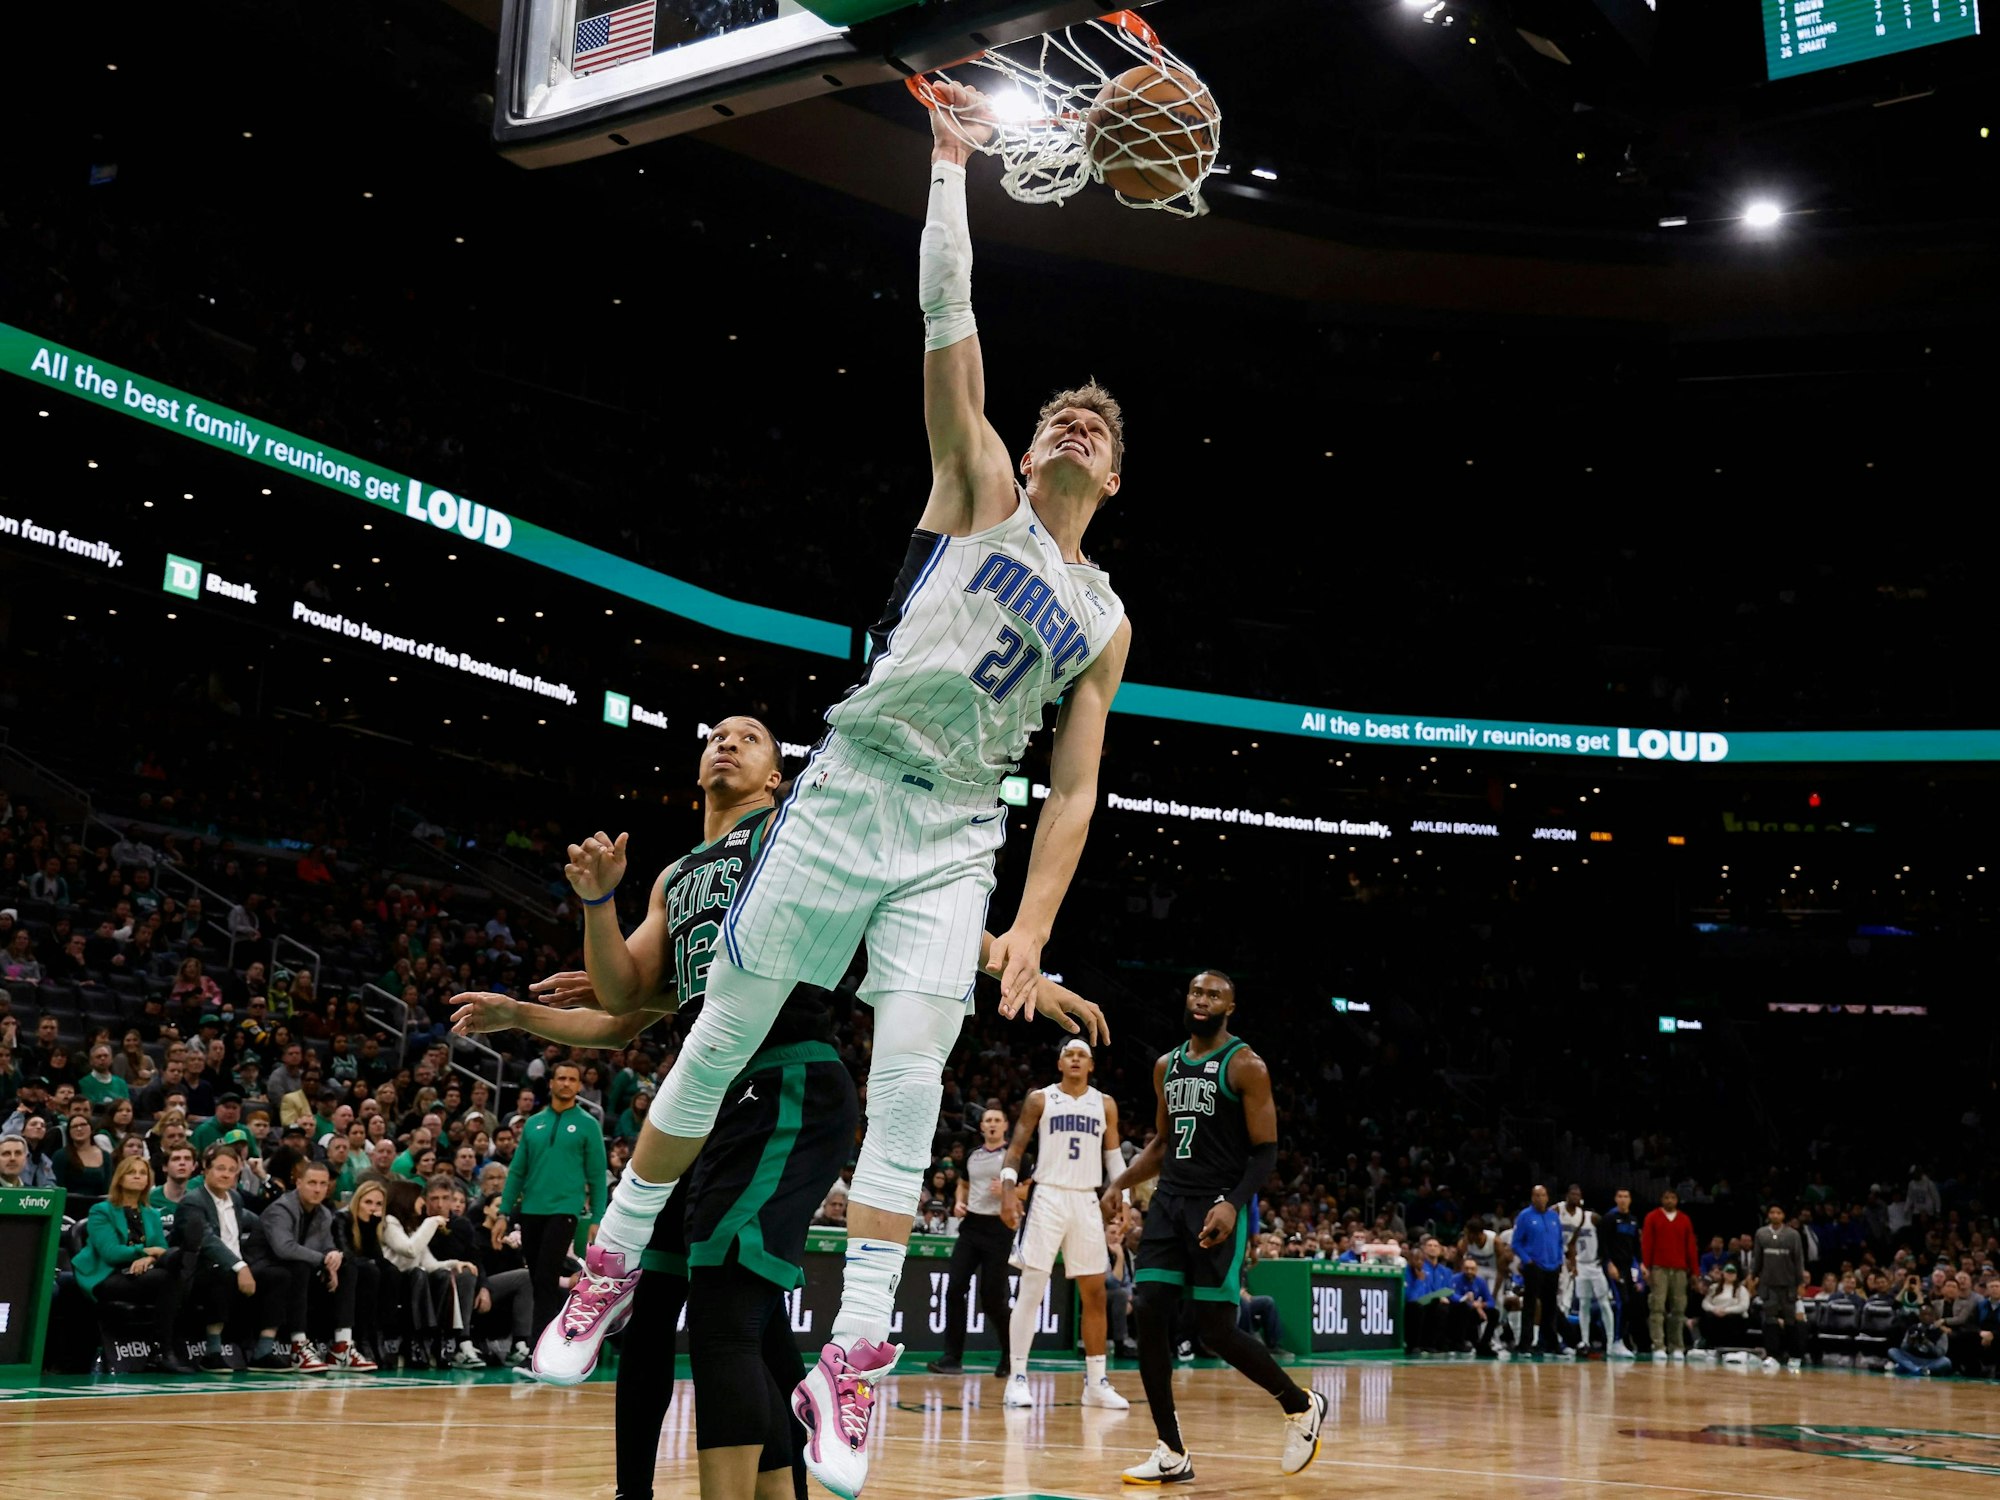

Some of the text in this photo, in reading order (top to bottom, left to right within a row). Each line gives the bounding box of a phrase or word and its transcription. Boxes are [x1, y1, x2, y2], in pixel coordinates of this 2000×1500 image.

[1795, 11, 1822, 27] WHITE
[1797, 21, 1837, 41] WILLIAMS
[1780, 46, 1793, 59] 36
[1798, 37, 1827, 55] SMART
[31, 348, 512, 549] All the best family reunions get LOUD
[21, 518, 56, 547] fan
[58, 529, 123, 568] family.
[169, 561, 258, 604] TD Bank
[964, 551, 1090, 684] MAGIC
[293, 601, 578, 706] Proud to be part of the Boston fan family.
[969, 624, 1041, 704] 21
[607, 696, 668, 729] TD Bank
[781, 742, 811, 758] par
[1301, 711, 1729, 761] All the best family reunions get LOUD
[728, 829, 750, 841] VISTA
[1108, 793, 1392, 839] Proud to be part of the Boston fan family.
[1410, 820, 1499, 836] JAYLEN BROWN.
[1532, 828, 1576, 841] JAYSON
[724, 837, 749, 848] PRINT
[666, 857, 742, 938] CELTICS
[1165, 1078, 1217, 1116] CELTICS
[1050, 1114, 1100, 1137] MAGIC
[1175, 1116, 1196, 1159] 7
[1069, 1137, 1080, 1160] 5
[19, 1196, 50, 1209] xfinity
[929, 1272, 985, 1334] JL
[1312, 1286, 1393, 1335] JBL JBL
